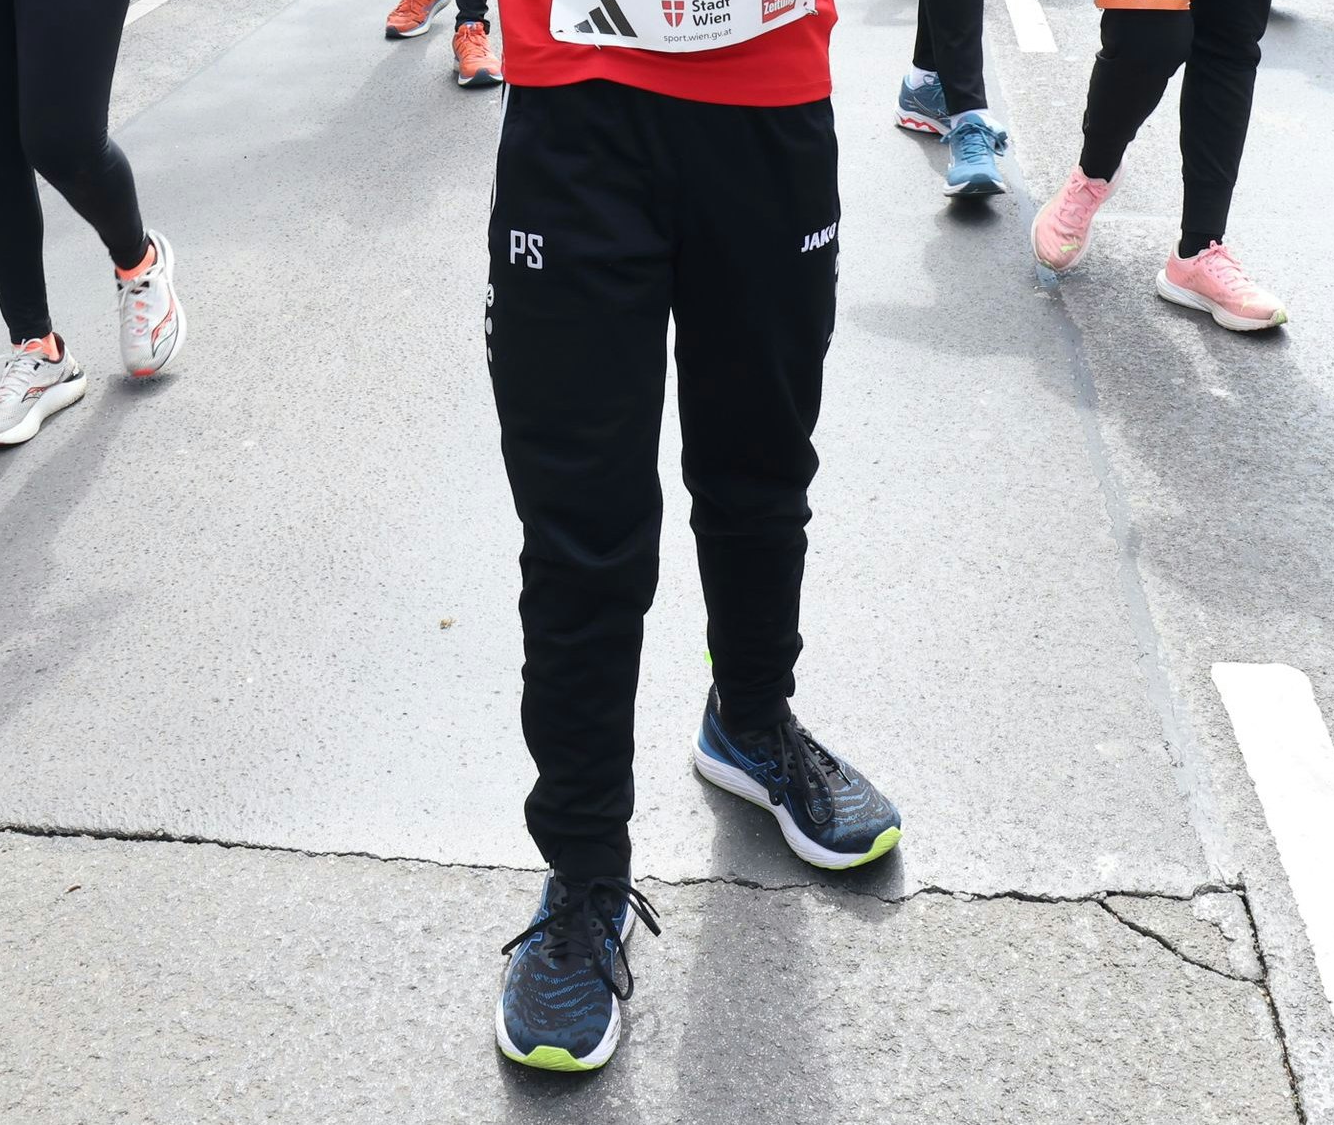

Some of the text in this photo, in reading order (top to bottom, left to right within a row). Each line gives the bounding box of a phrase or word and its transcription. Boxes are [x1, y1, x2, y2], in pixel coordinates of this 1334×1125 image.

[693, 11, 732, 27] Wien
[663, 28, 733, 44] sport.wien.gv.at
[800, 222, 837, 253] JAKO
[510, 230, 544, 270] PS
